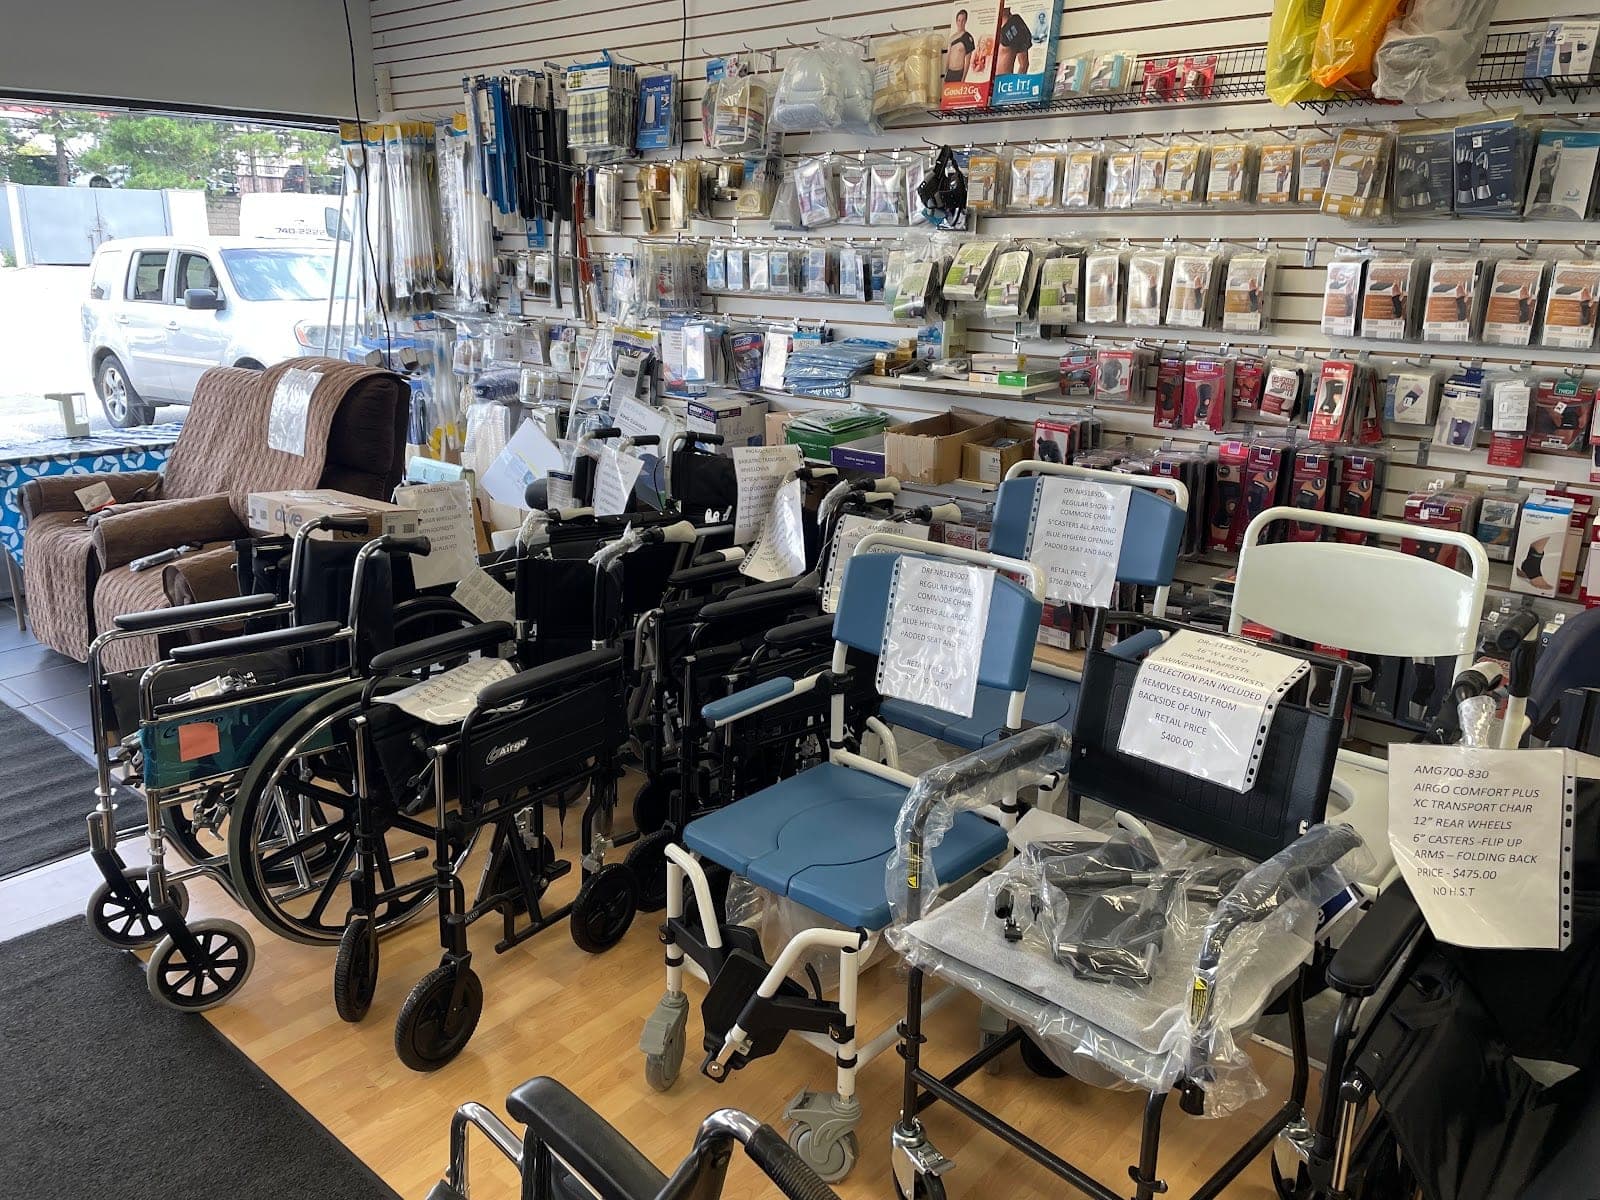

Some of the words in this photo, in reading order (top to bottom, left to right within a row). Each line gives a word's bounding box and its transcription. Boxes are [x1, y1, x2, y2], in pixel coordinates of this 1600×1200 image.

[998, 82, 1013, 93] ICE
[1017, 79, 1030, 90] IT!
[1060, 509, 1093, 518] COMMODE
[1090, 525, 1117, 533] AROUND
[1044, 541, 1068, 550] PADDED
[1062, 532, 1086, 541] HYGIENE
[1088, 537, 1113, 545] OPENING
[920, 581, 948, 591] REGULAR
[949, 585, 974, 595] SHOWE
[953, 599, 972, 608] CHAIR
[902, 617, 917, 626] BLUE
[920, 620, 945, 632] HYGIENE
[901, 631, 925, 640] PADDED
[927, 636, 940, 644] SEAT
[1190, 662, 1215, 674] AWAY
[1148, 663, 1196, 683] COLLECTION
[1198, 678, 1216, 688] PAN
[1217, 682, 1262, 701] INCLUDED
[1142, 677, 1181, 695] REMOVES
[1183, 689, 1210, 703] EASILY
[1210, 697, 1237, 712] FROM
[1138, 690, 1176, 709] BACKSIDE
[1178, 702, 1189, 712] OF
[1191, 707, 1212, 718] UNIT
[1155, 712, 1182, 727] RETAIL
[1184, 721, 1207, 736] PRICE
[1161, 731, 1194, 748] $400.00
[499, 739, 526, 755] Airgo
[1414, 765, 1489, 779] AMG700-830
[1414, 783, 1450, 794] AIRGO
[1453, 786, 1510, 797] COMFORT
[1512, 789, 1540, 798] PLUS
[1413, 799, 1428, 808] XC
[1432, 800, 1497, 812] TRANSPORT
[1499, 804, 1533, 813] CHAIR
[1436, 818, 1464, 828] REAR
[1468, 820, 1512, 830] WHEELS
[1429, 835, 1474, 846] CASTERS
[1507, 839, 1522, 847] UP
[1414, 850, 1444, 859] ARMS
[1456, 852, 1505, 863] FOLDING
[1509, 854, 1538, 864] BACK
[1417, 868, 1443, 878] PRICE
[1452, 869, 1497, 880] $475.00
[1433, 887, 1446, 896] NO
[1449, 888, 1475, 896] H.S.T
